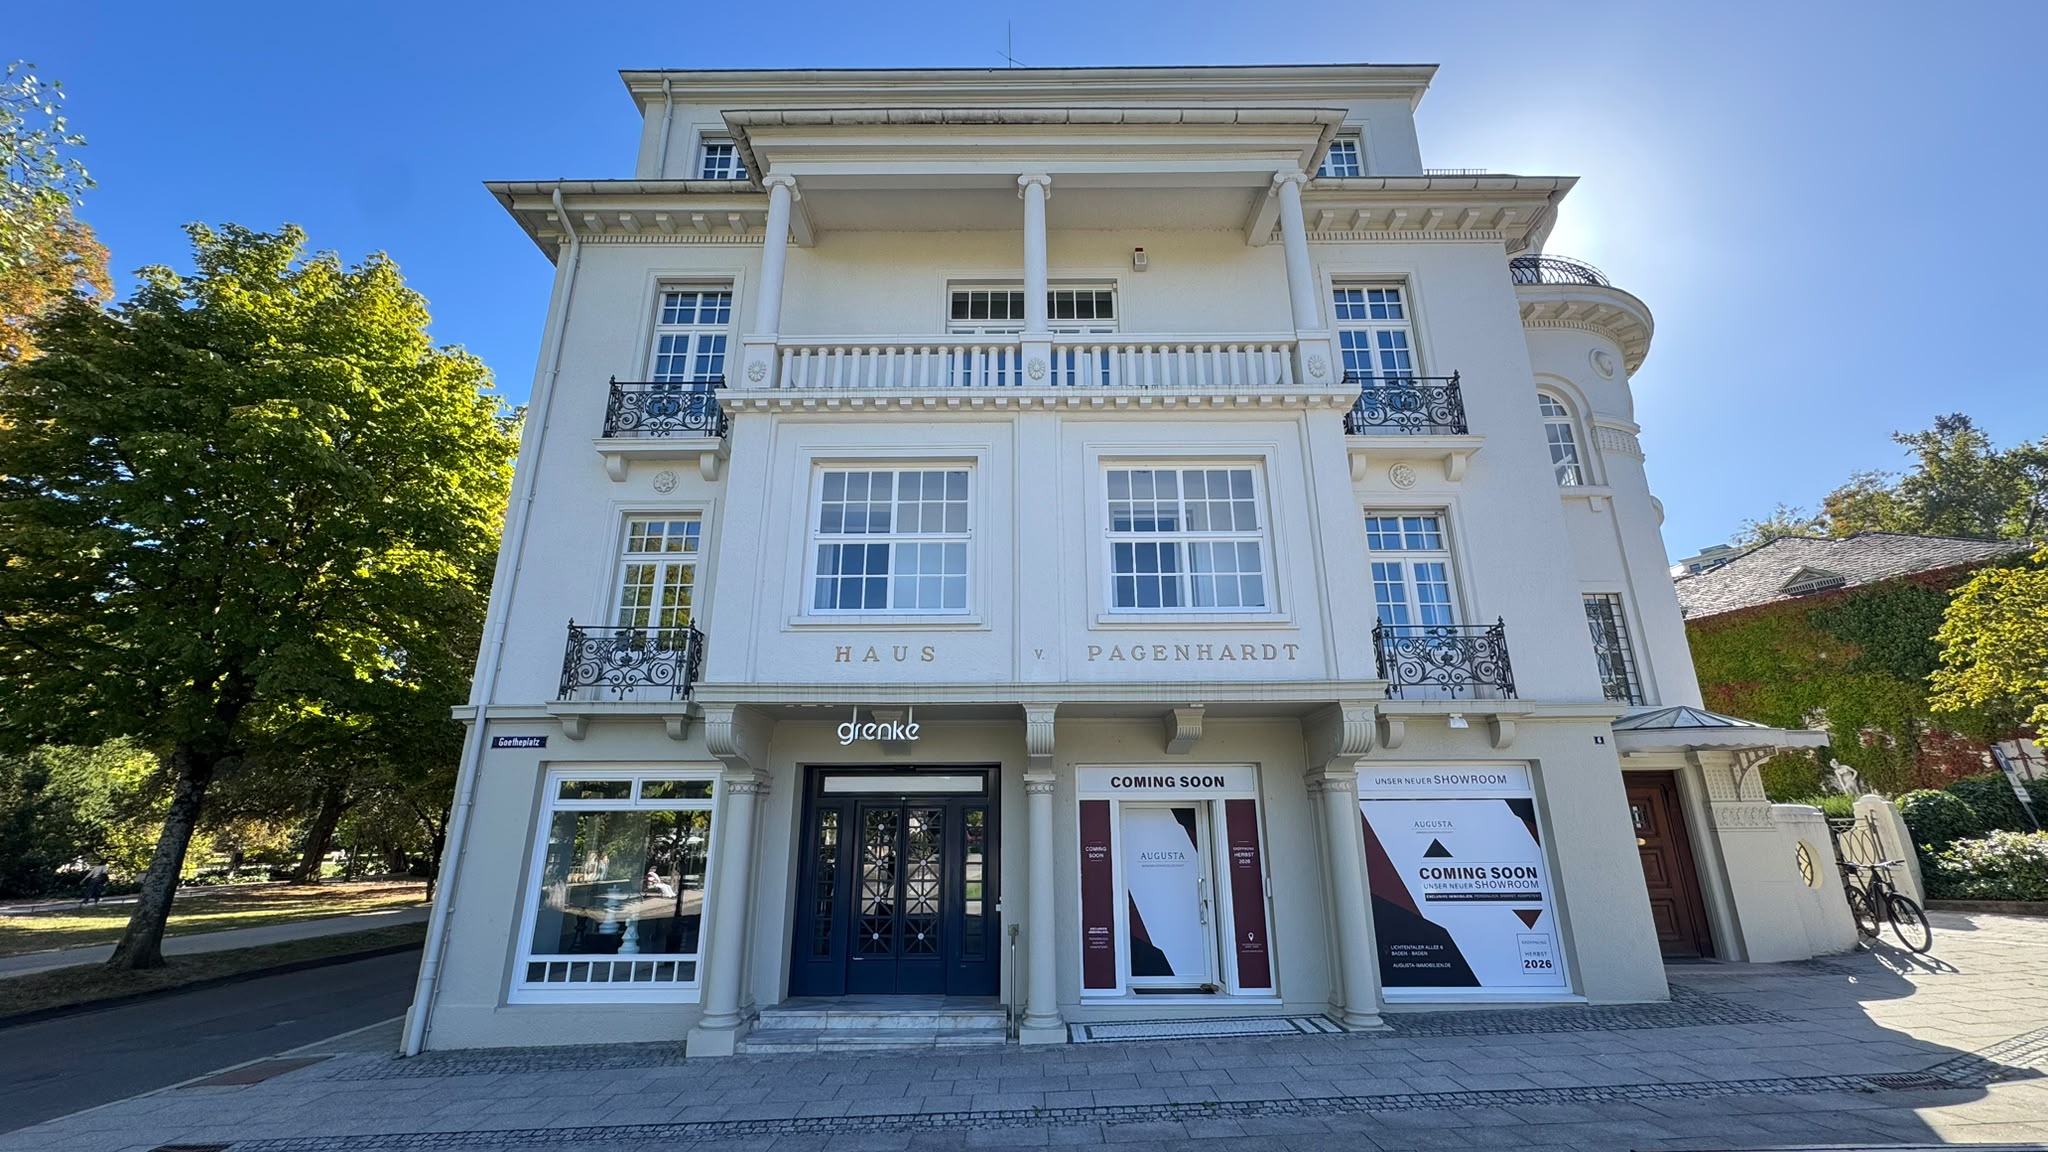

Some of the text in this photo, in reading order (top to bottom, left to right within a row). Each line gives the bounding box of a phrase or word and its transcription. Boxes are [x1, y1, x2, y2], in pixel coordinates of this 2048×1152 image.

[835, 645, 936, 663] HAUS
[1087, 644, 1300, 662] PAGENHARDT
[837, 720, 920, 746] grenke
[498, 737, 540, 748] Goetheplatz
[1110, 776, 1225, 788] COMING SOON
[1375, 774, 1507, 785] UNSER NEUER SHOWROOM
[1413, 820, 1453, 828] AUGUSTA
[1140, 851, 1185, 860] AUGUSTA
[1419, 866, 1538, 879] COMING SOON
[1423, 882, 1448, 890] UNSER
[1474, 880, 1539, 889] SHOWROOM
[1524, 959, 1552, 969] 2026
